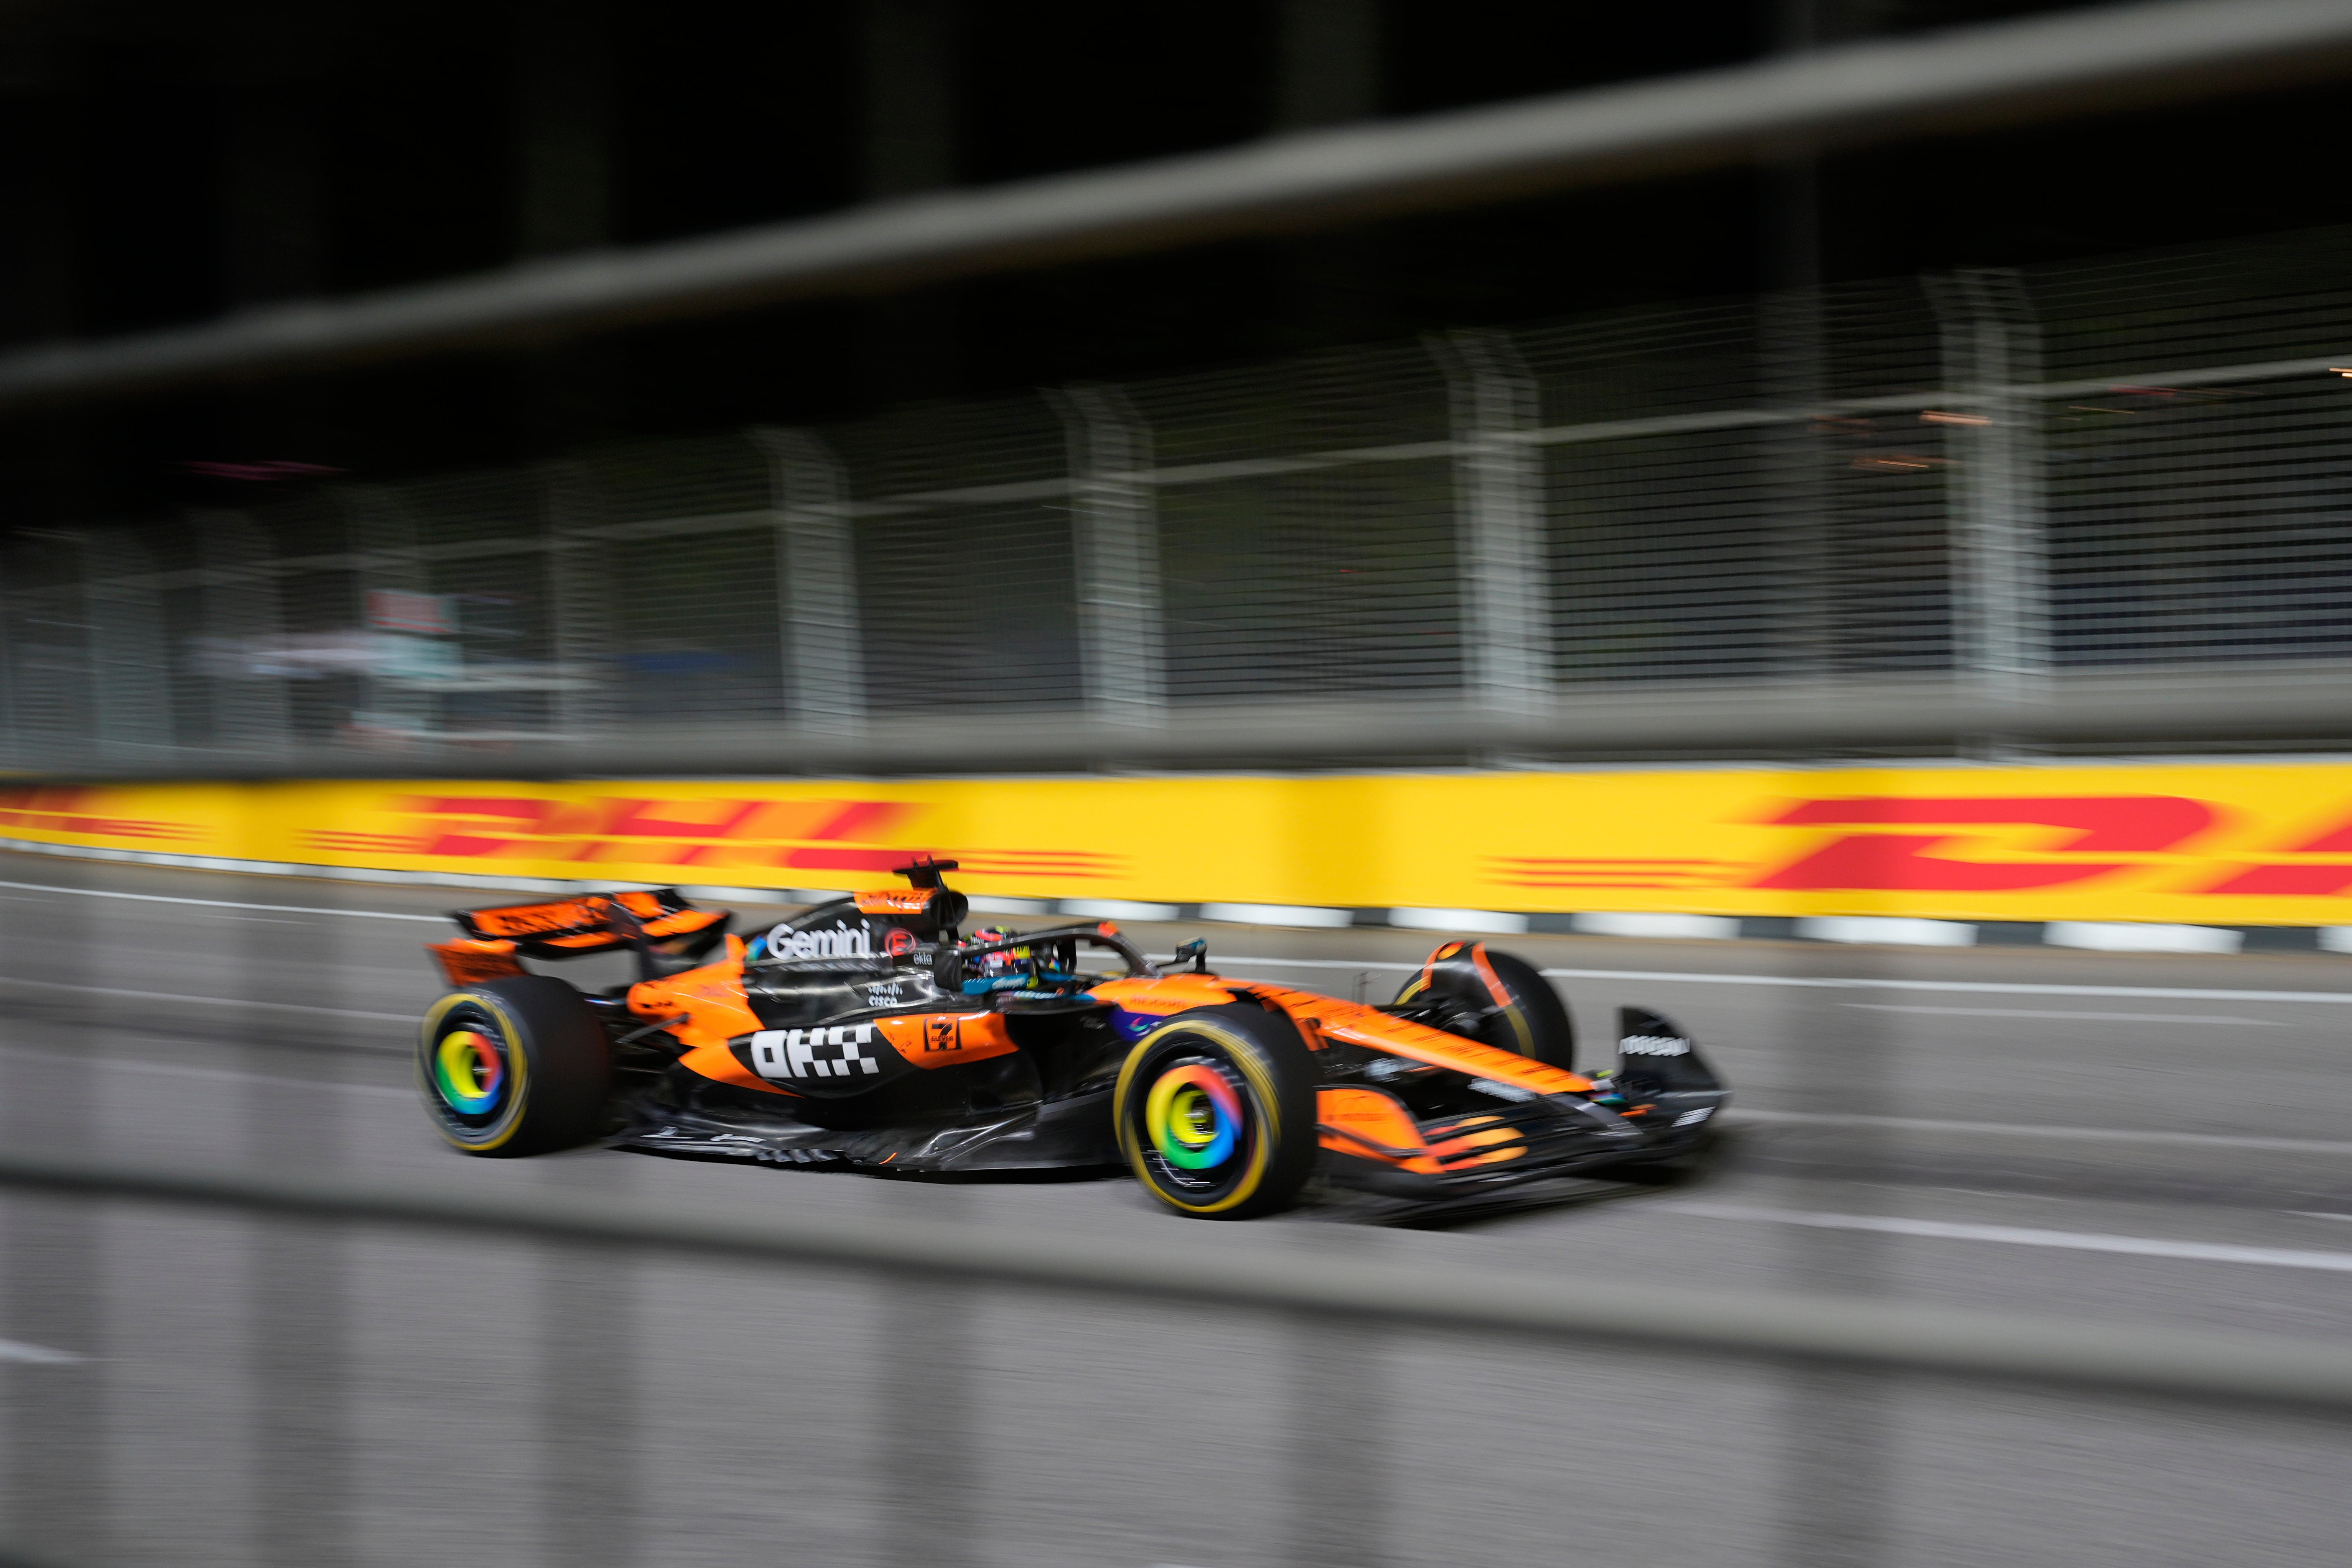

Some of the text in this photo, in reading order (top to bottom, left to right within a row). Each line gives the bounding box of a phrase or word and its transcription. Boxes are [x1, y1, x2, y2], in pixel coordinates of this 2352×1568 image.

[767, 918, 870, 960] Gemini
[913, 952, 933, 965] okta
[751, 1024, 879, 1078] OKX
